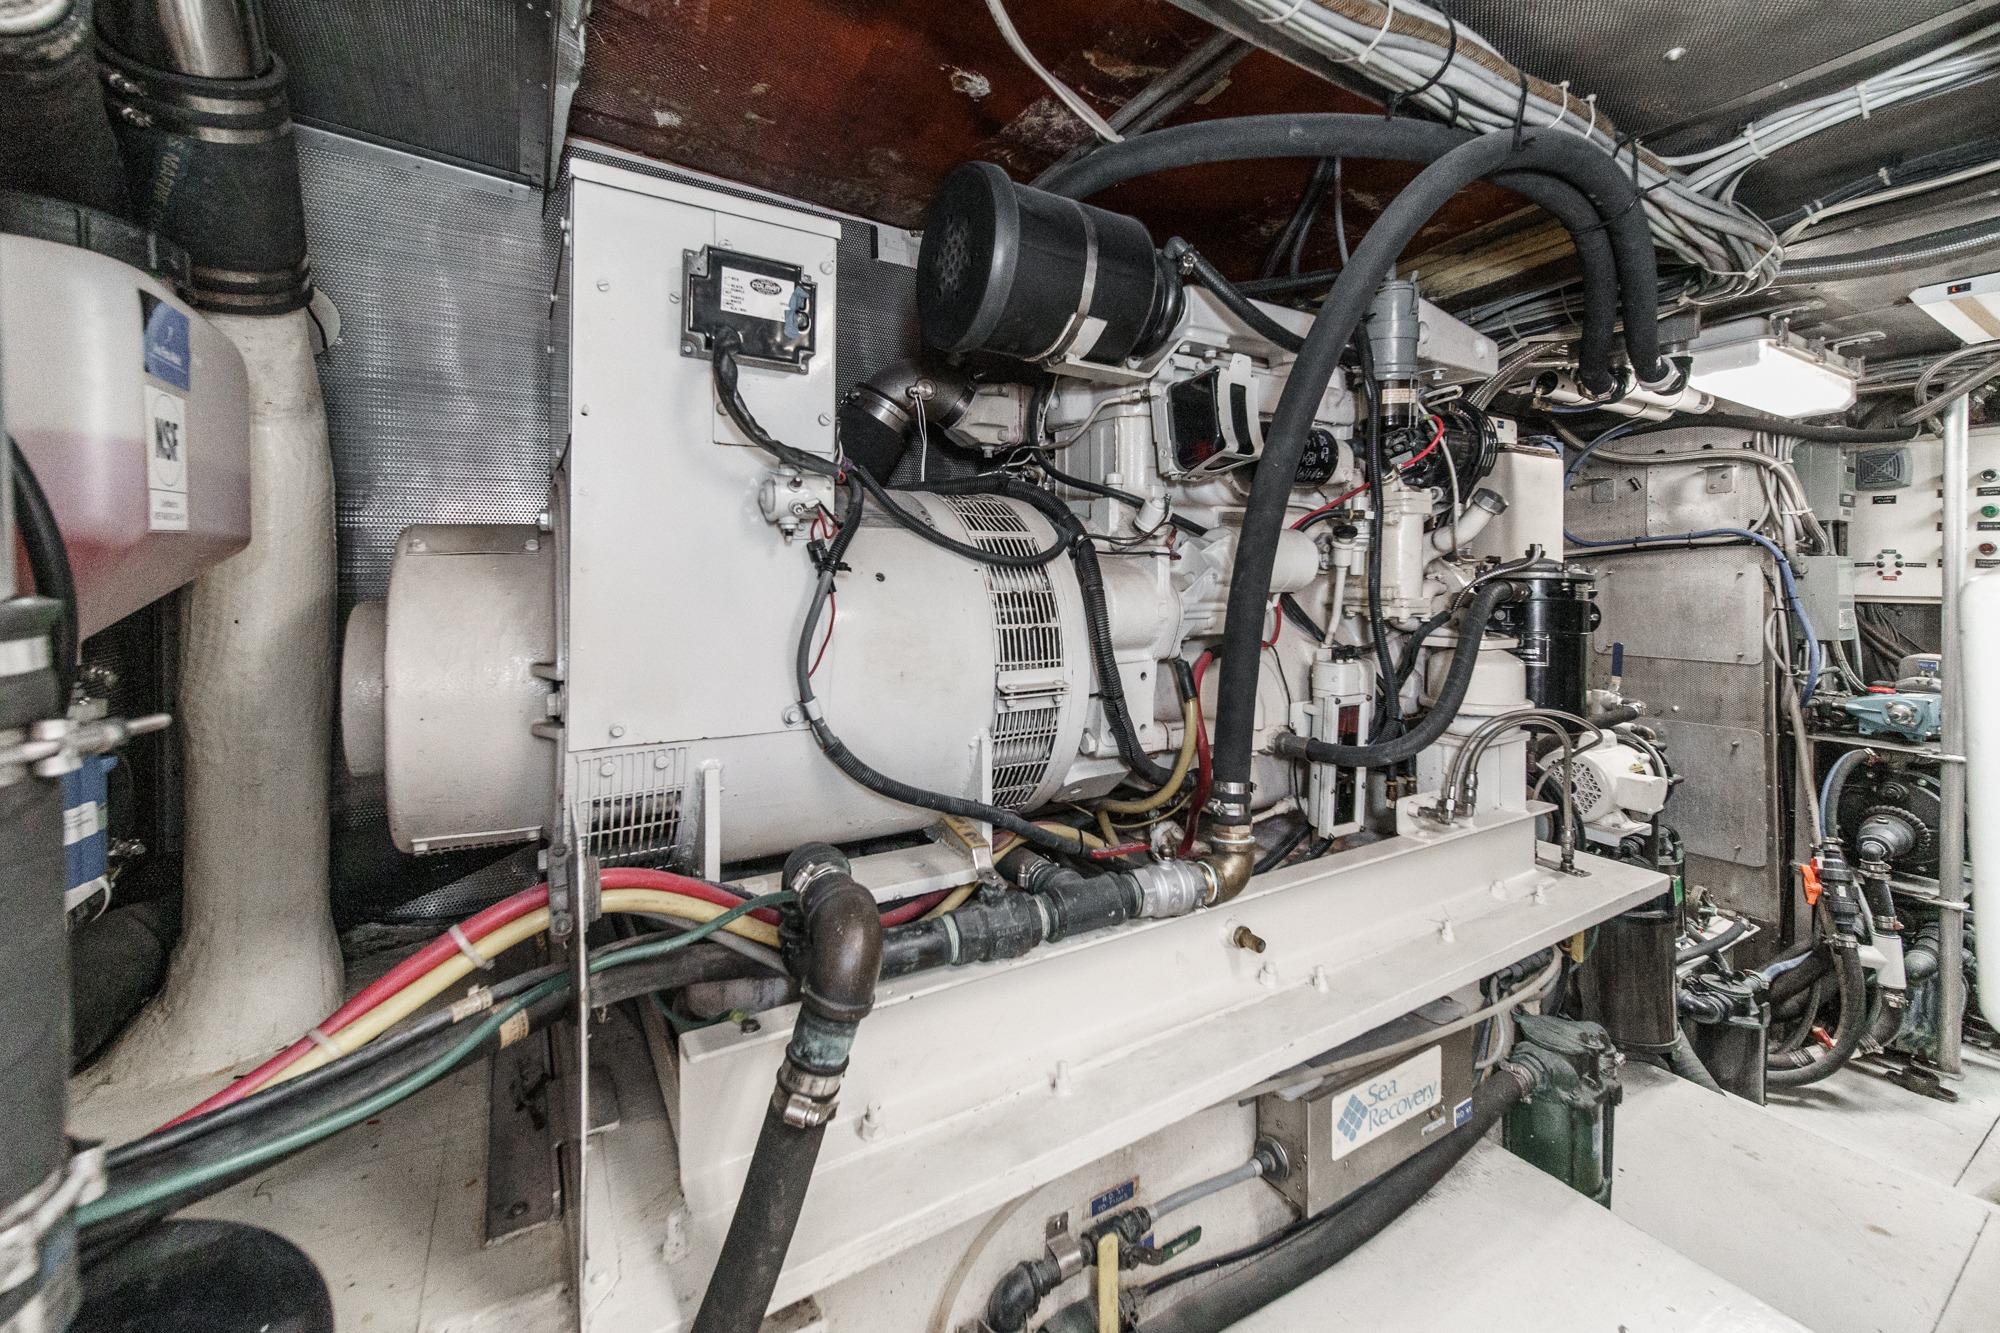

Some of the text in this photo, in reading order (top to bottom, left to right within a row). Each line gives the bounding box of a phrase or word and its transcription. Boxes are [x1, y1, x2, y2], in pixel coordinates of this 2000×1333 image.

[154, 416, 179, 462] NSF
[1367, 1078, 1398, 1107] Sea
[1367, 1080, 1438, 1132] Recovery
